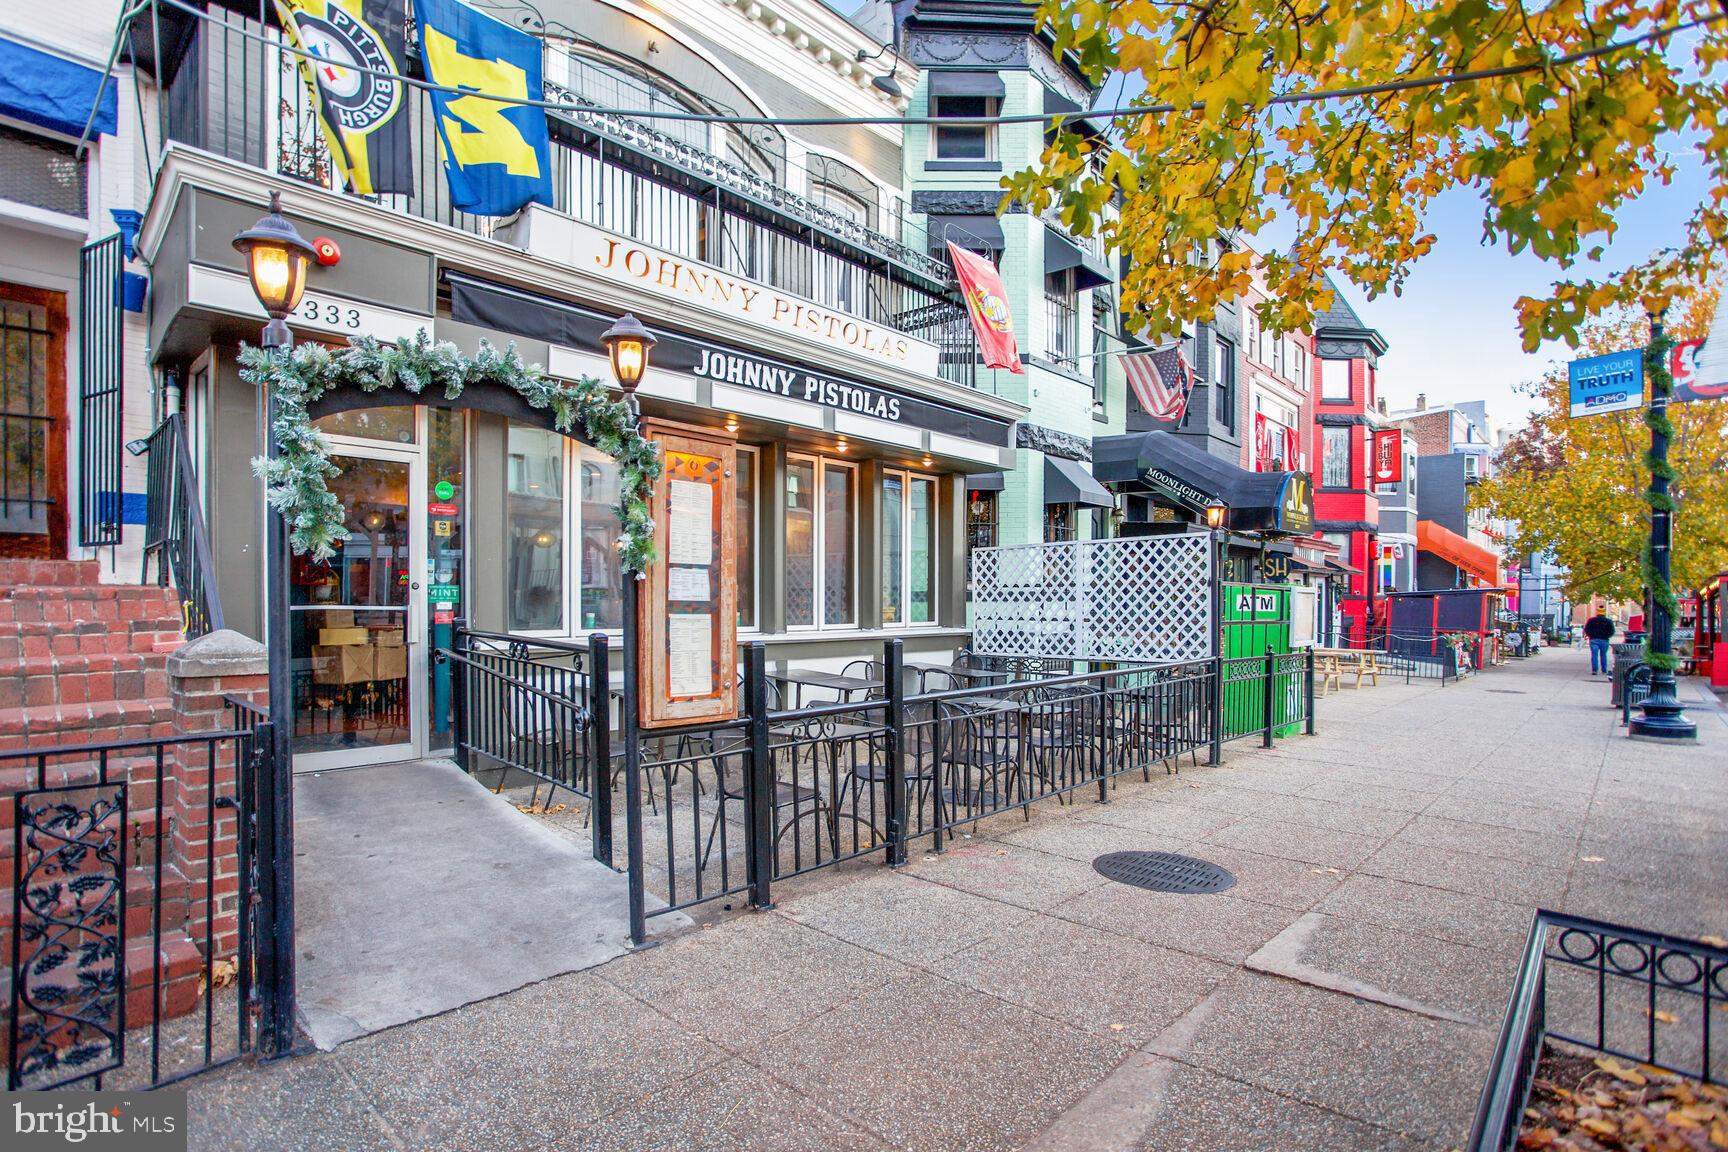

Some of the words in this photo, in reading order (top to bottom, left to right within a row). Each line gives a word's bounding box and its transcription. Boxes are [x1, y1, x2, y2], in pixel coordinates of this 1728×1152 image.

[333, 10, 394, 127] PITTSBURGH
[289, 300, 361, 329] 333
[594, 237, 760, 312] JOHNNY
[771, 296, 909, 361] PISTOLAS
[1577, 365, 1600, 377] LIVE
[1602, 358, 1634, 372] YOUR
[1577, 369, 1634, 390] TRUTH
[693, 349, 798, 397] JOHNNY
[804, 375, 901, 421] PISTOLAS
[1146, 467, 1205, 501] MOONLIGHT
[1265, 557, 1287, 577] SH
